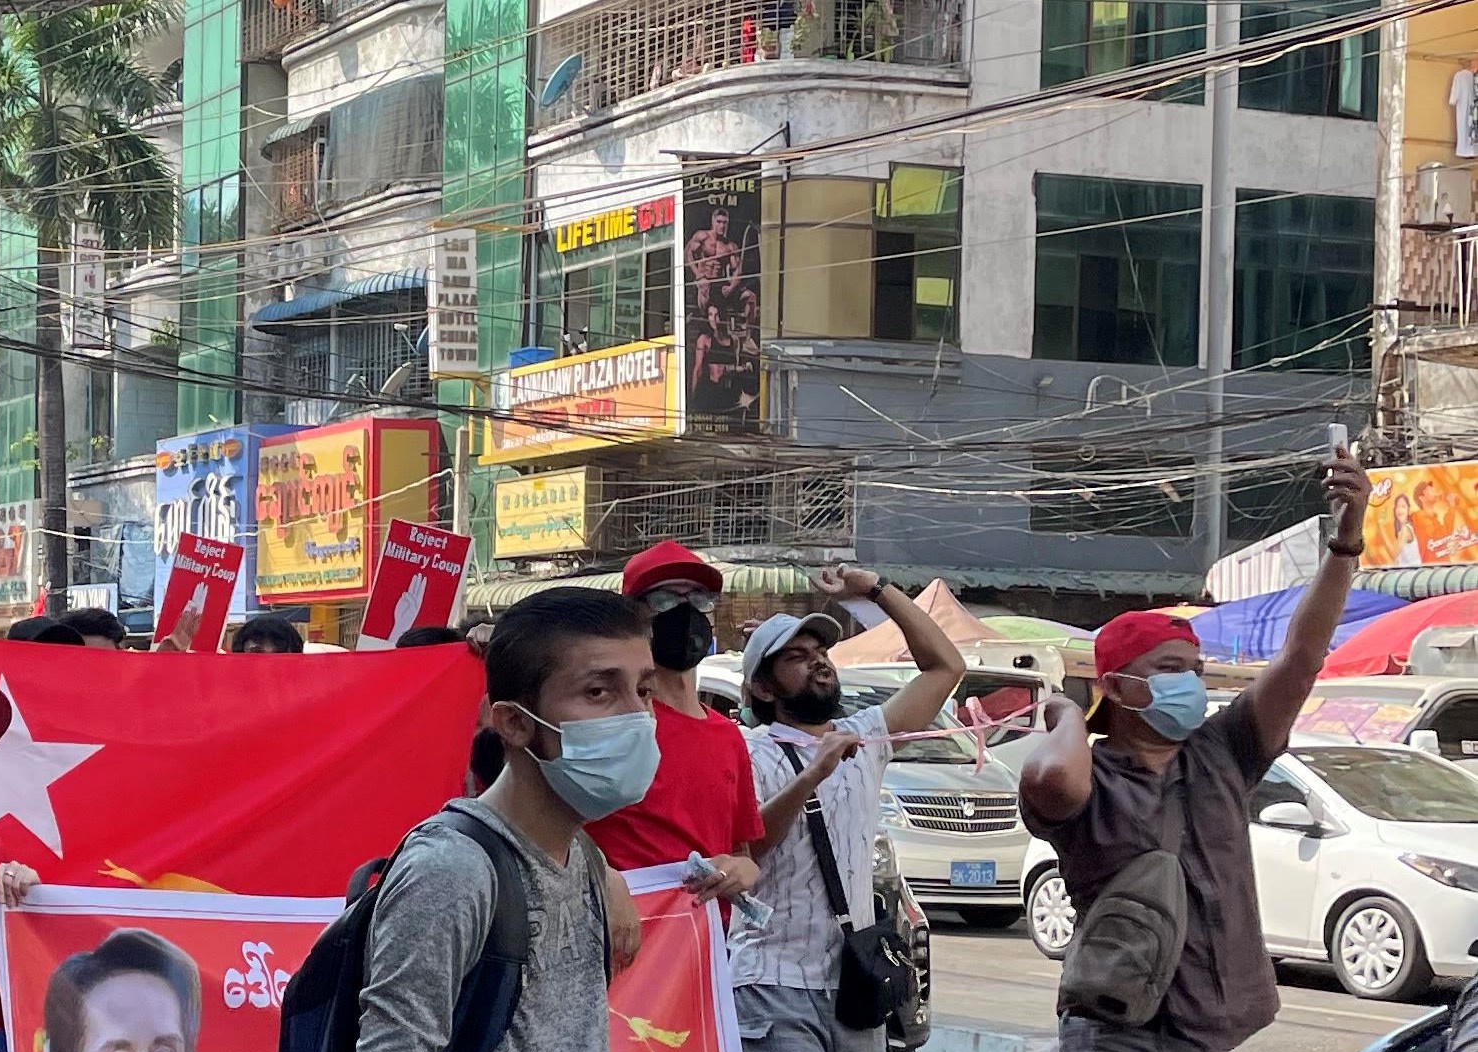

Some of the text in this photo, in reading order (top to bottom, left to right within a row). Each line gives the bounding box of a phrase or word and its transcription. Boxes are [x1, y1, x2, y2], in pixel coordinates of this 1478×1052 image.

[556, 206, 635, 253] LIFETIME
[438, 293, 477, 306] PLAZA
[574, 357, 615, 394] PLAZA
[617, 349, 659, 384] HOTEL
[194, 538, 226, 558] Reject
[409, 526, 448, 549] Reject
[174, 553, 211, 578] Military
[212, 562, 236, 583] Coup
[384, 541, 430, 569] Military
[431, 553, 461, 576] Coup
